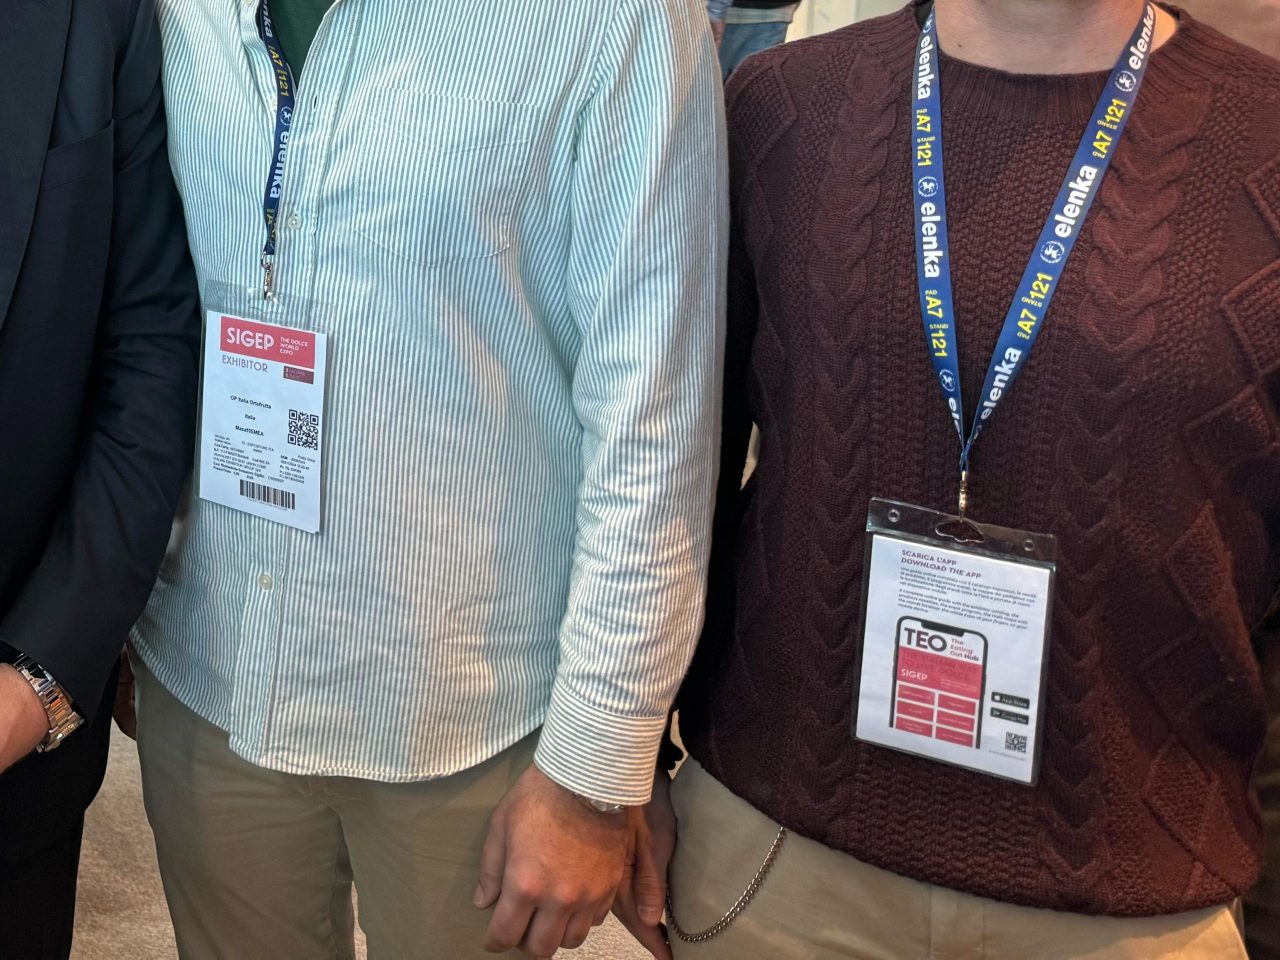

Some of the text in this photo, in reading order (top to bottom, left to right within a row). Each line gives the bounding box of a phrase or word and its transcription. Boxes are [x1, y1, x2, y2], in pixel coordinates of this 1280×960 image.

[278, 72, 289, 97] 121
[917, 35, 948, 358] elenka A7 121 elenka A7 121
[980, 5, 1154, 420] elenka A7 121 elenka A7 121 elenka
[1021, 296, 1043, 308] STAND
[226, 326, 275, 351] SIGEP
[280, 343, 300, 351] WORLD
[290, 338, 309, 347] DOLCE
[280, 348, 294, 356] EXPO
[222, 354, 268, 373] EXHIBITOR
[901, 549, 957, 566] SCARICA L'APP
[901, 557, 982, 579] DOWNLOAD THE APP
[903, 627, 948, 652] TEO
[950, 643, 973, 654] Eating
[950, 650, 979, 662] Out Hub
[901, 668, 928, 681] SIGEP
